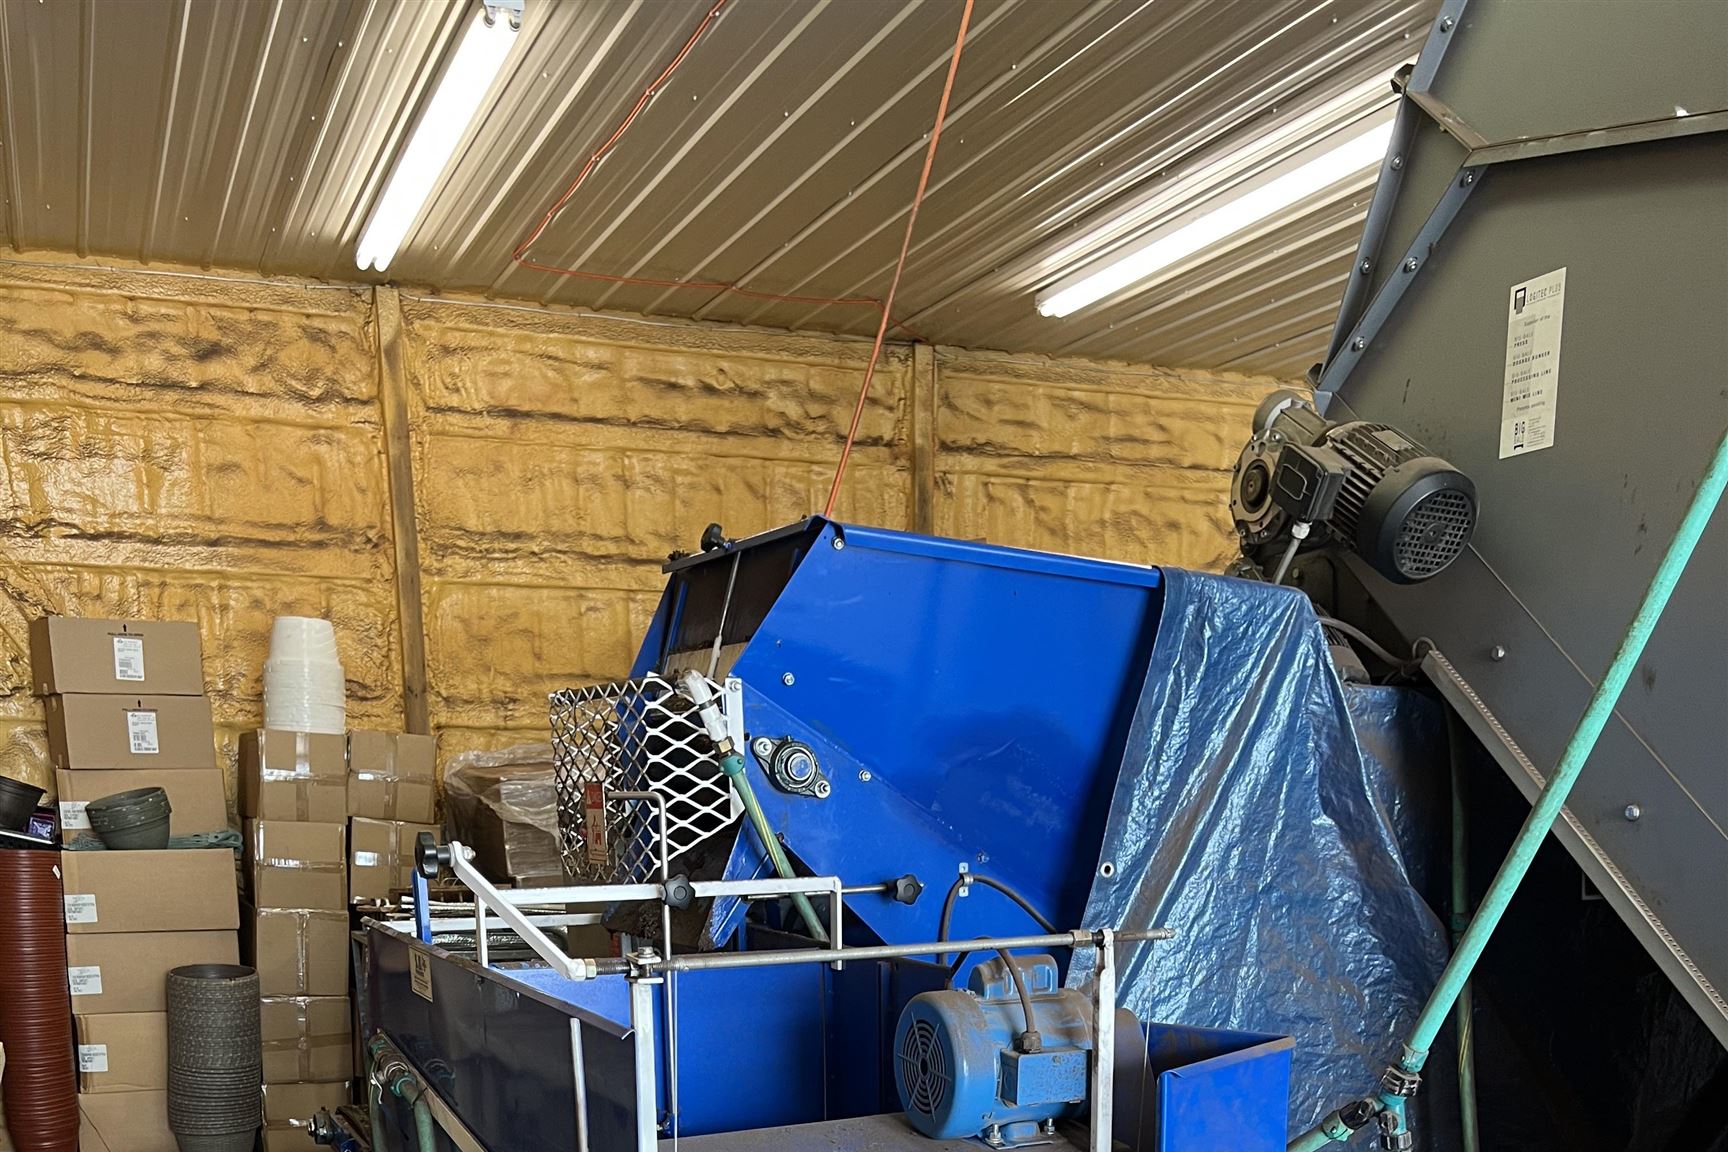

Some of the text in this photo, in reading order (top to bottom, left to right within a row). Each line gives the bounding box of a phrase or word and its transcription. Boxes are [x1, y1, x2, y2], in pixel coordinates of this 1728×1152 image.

[1526, 282, 1562, 303] LOGITEC PLUS
[1514, 421, 1526, 436] BIG
